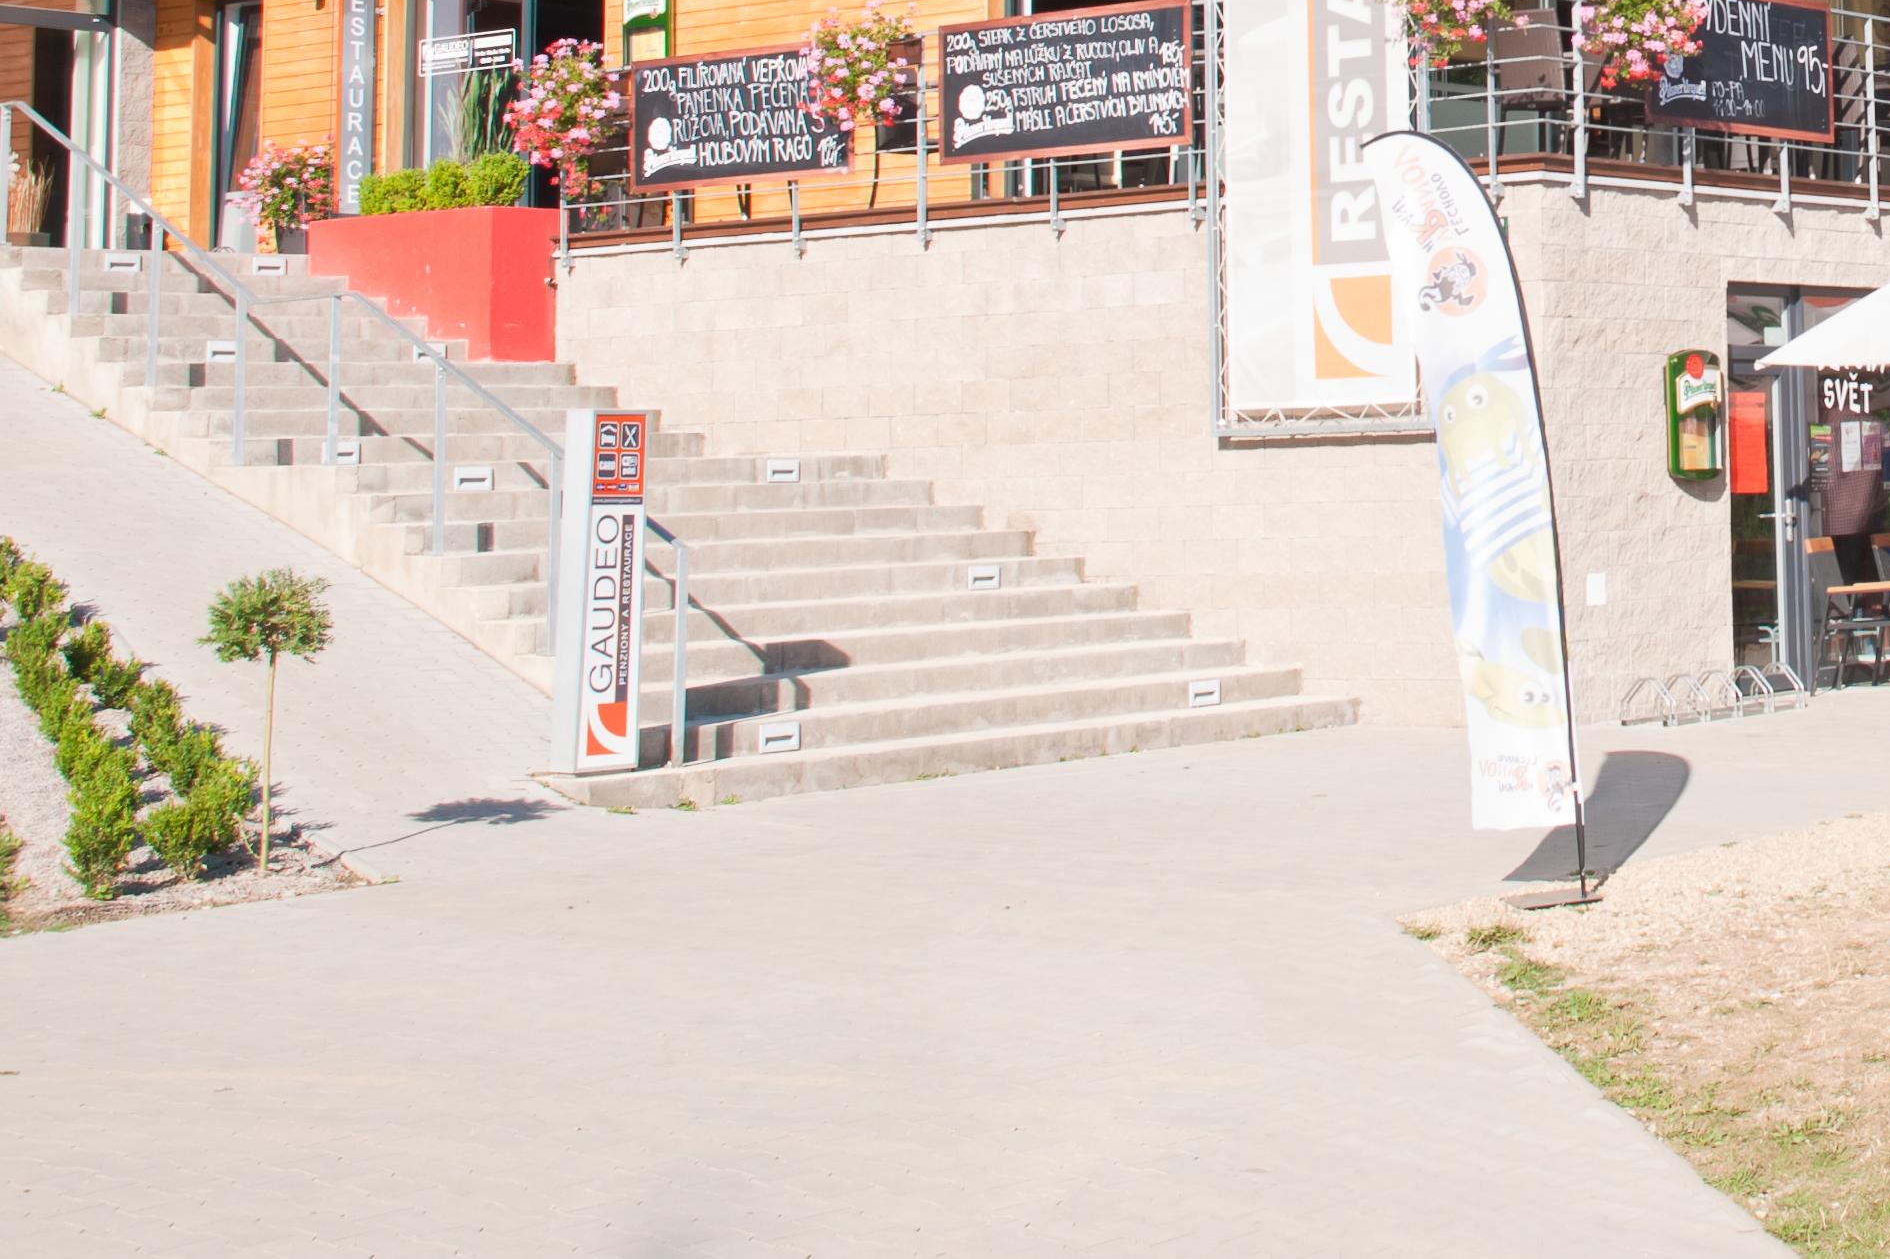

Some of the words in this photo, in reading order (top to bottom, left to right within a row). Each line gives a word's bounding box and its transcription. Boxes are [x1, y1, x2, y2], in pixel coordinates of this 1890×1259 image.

[978, 28, 1013, 47] STEAK
[1101, 12, 1154, 33] LOSOSA,
[1005, 48, 1023, 67] NA
[1119, 38, 1145, 57] OLIV
[1149, 36, 1158, 54] A
[1741, 41, 1793, 85] MENU
[676, 88, 745, 115] PANENKA
[1011, 84, 1057, 107] PSTRUH
[1112, 71, 1131, 93] NA
[699, 135, 770, 167] HOUBOVÝM
[1823, 372, 1873, 414] SVĚT
[621, 524, 633, 604] RESTAURACE
[589, 514, 619, 693] GAUDEO
[623, 609, 630, 618] A
[619, 624, 630, 685] PENZIONY
